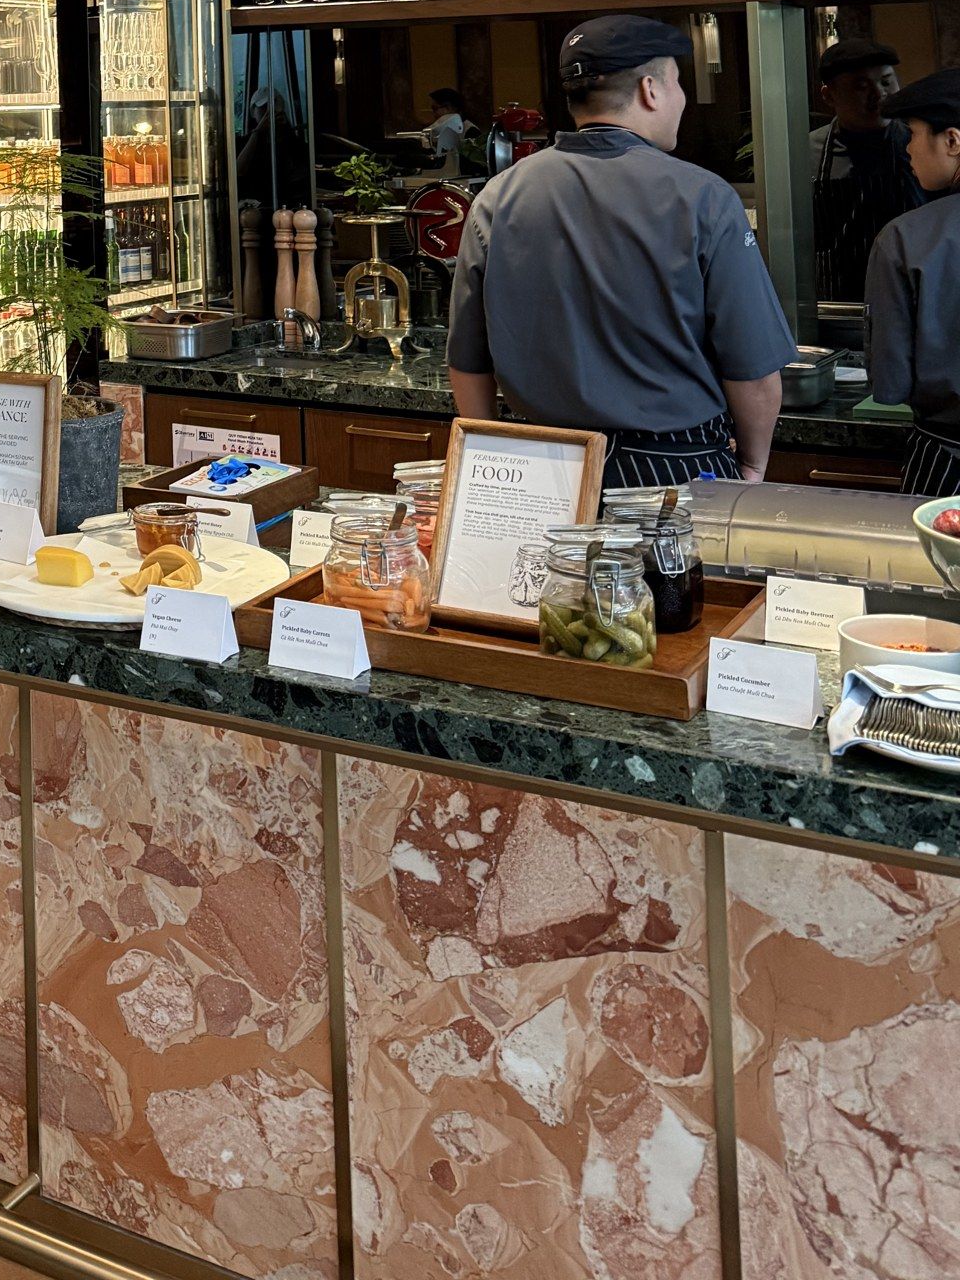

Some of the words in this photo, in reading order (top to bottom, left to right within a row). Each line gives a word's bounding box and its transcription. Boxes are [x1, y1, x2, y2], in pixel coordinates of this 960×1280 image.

[9, 399, 31, 408] WITH
[473, 453, 530, 465] FERMENTATION
[472, 465, 523, 483] FOOD
[718, 673, 739, 682] Pickled
[741, 677, 770, 687] Cucumber
